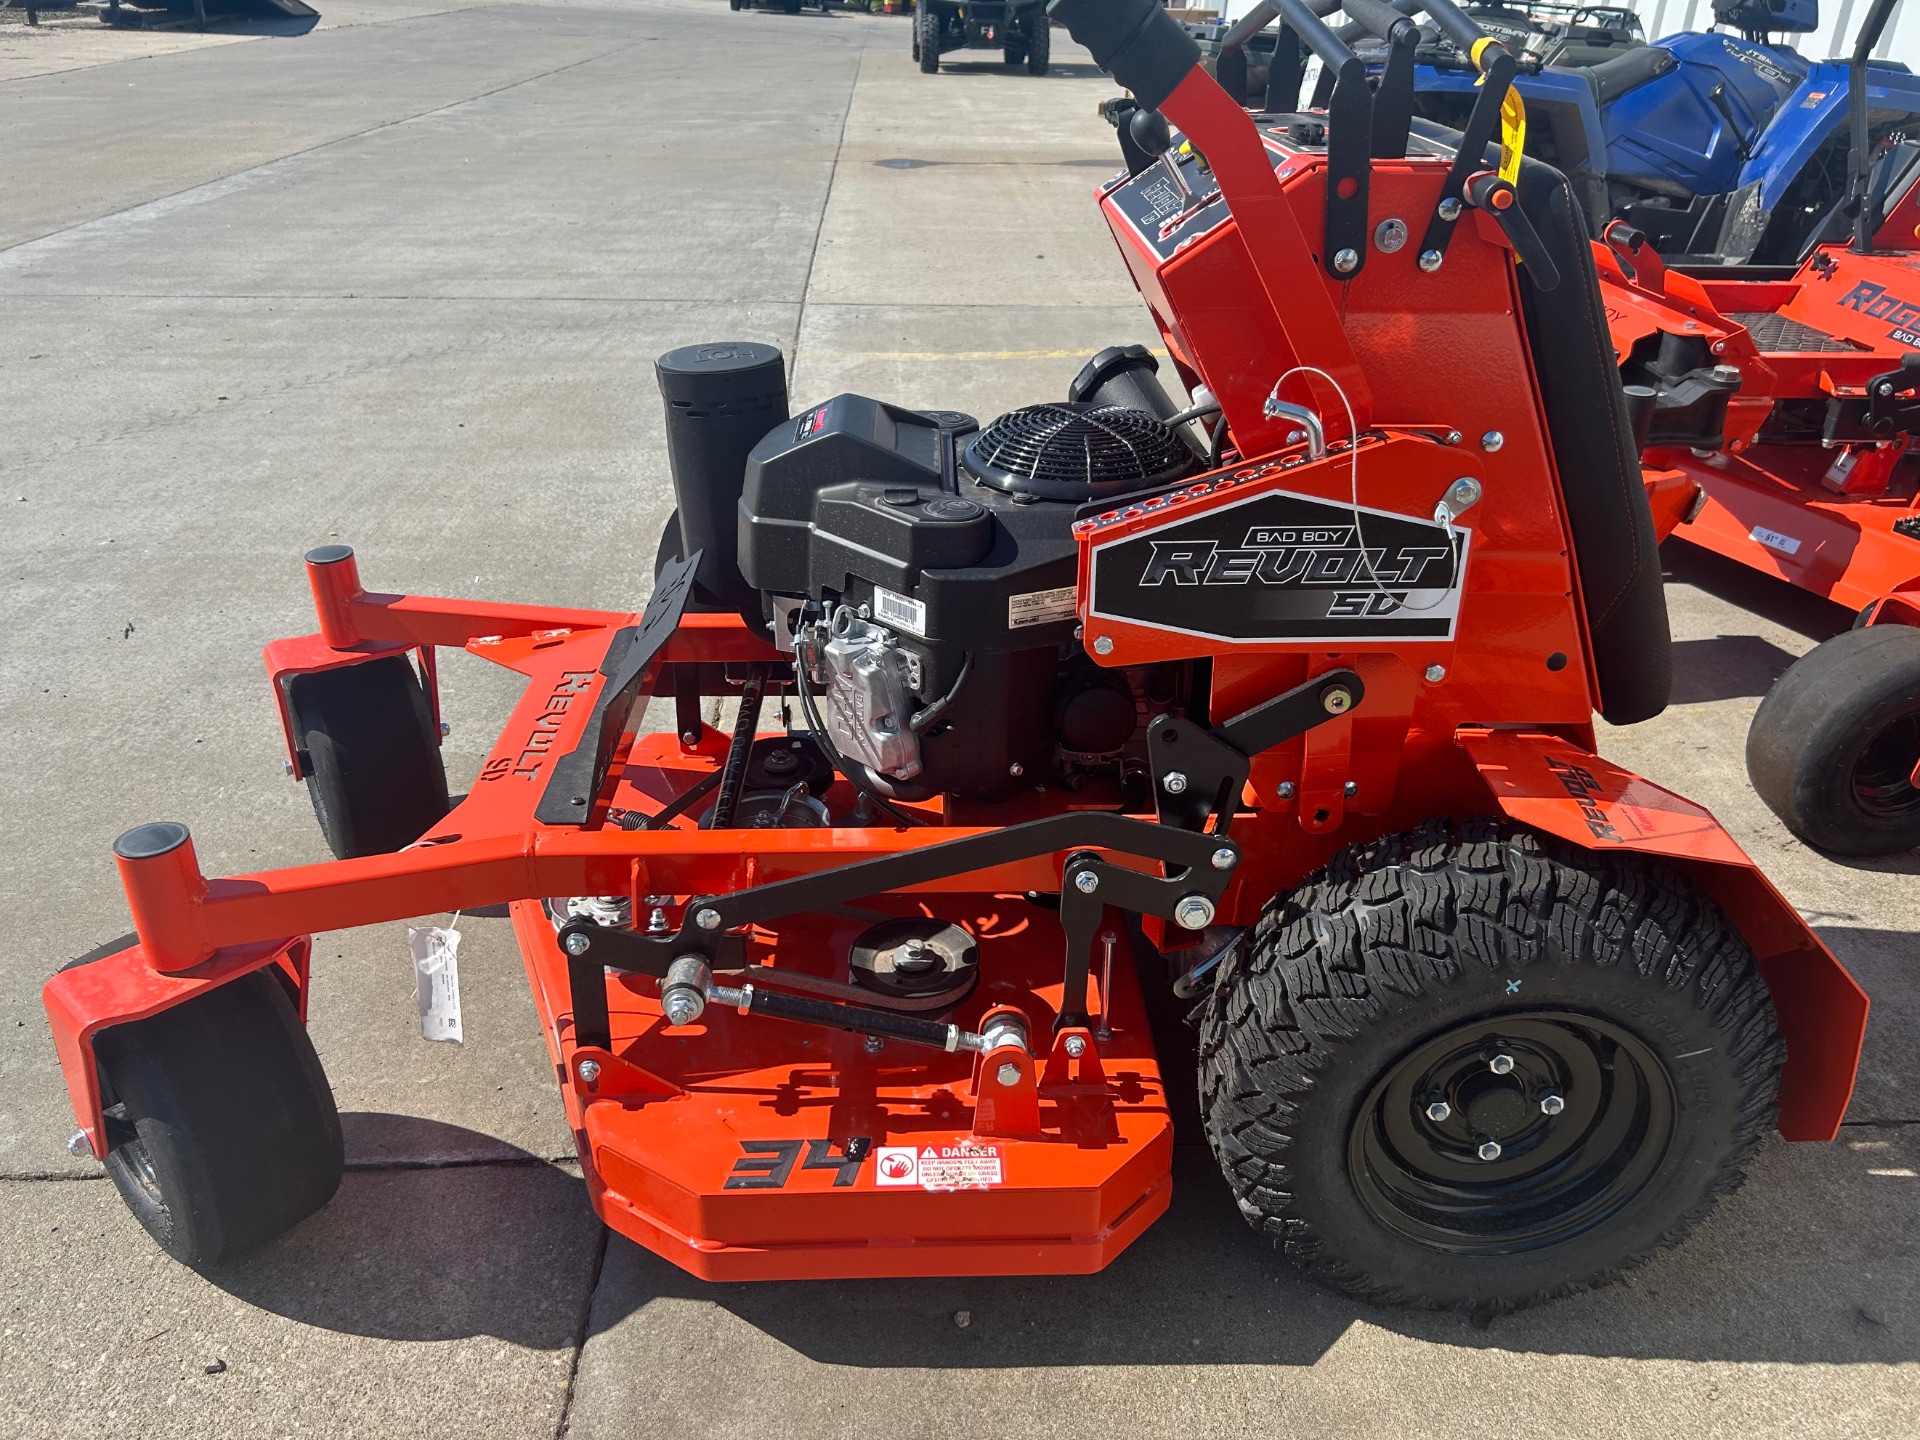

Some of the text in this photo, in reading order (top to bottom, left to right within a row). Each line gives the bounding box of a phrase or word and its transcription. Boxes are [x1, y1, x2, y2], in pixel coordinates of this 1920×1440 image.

[1892, 330, 1914, 343] BAD
[1256, 531, 1343, 542] BAD BOY
[1138, 540, 1450, 586] REVOLT
[1325, 590, 1409, 618] SD
[513, 668, 598, 782] REVOLT
[1543, 755, 1625, 843] REVOLT
[722, 1136, 872, 1190] 34
[942, 1146, 998, 1158] DANGER
